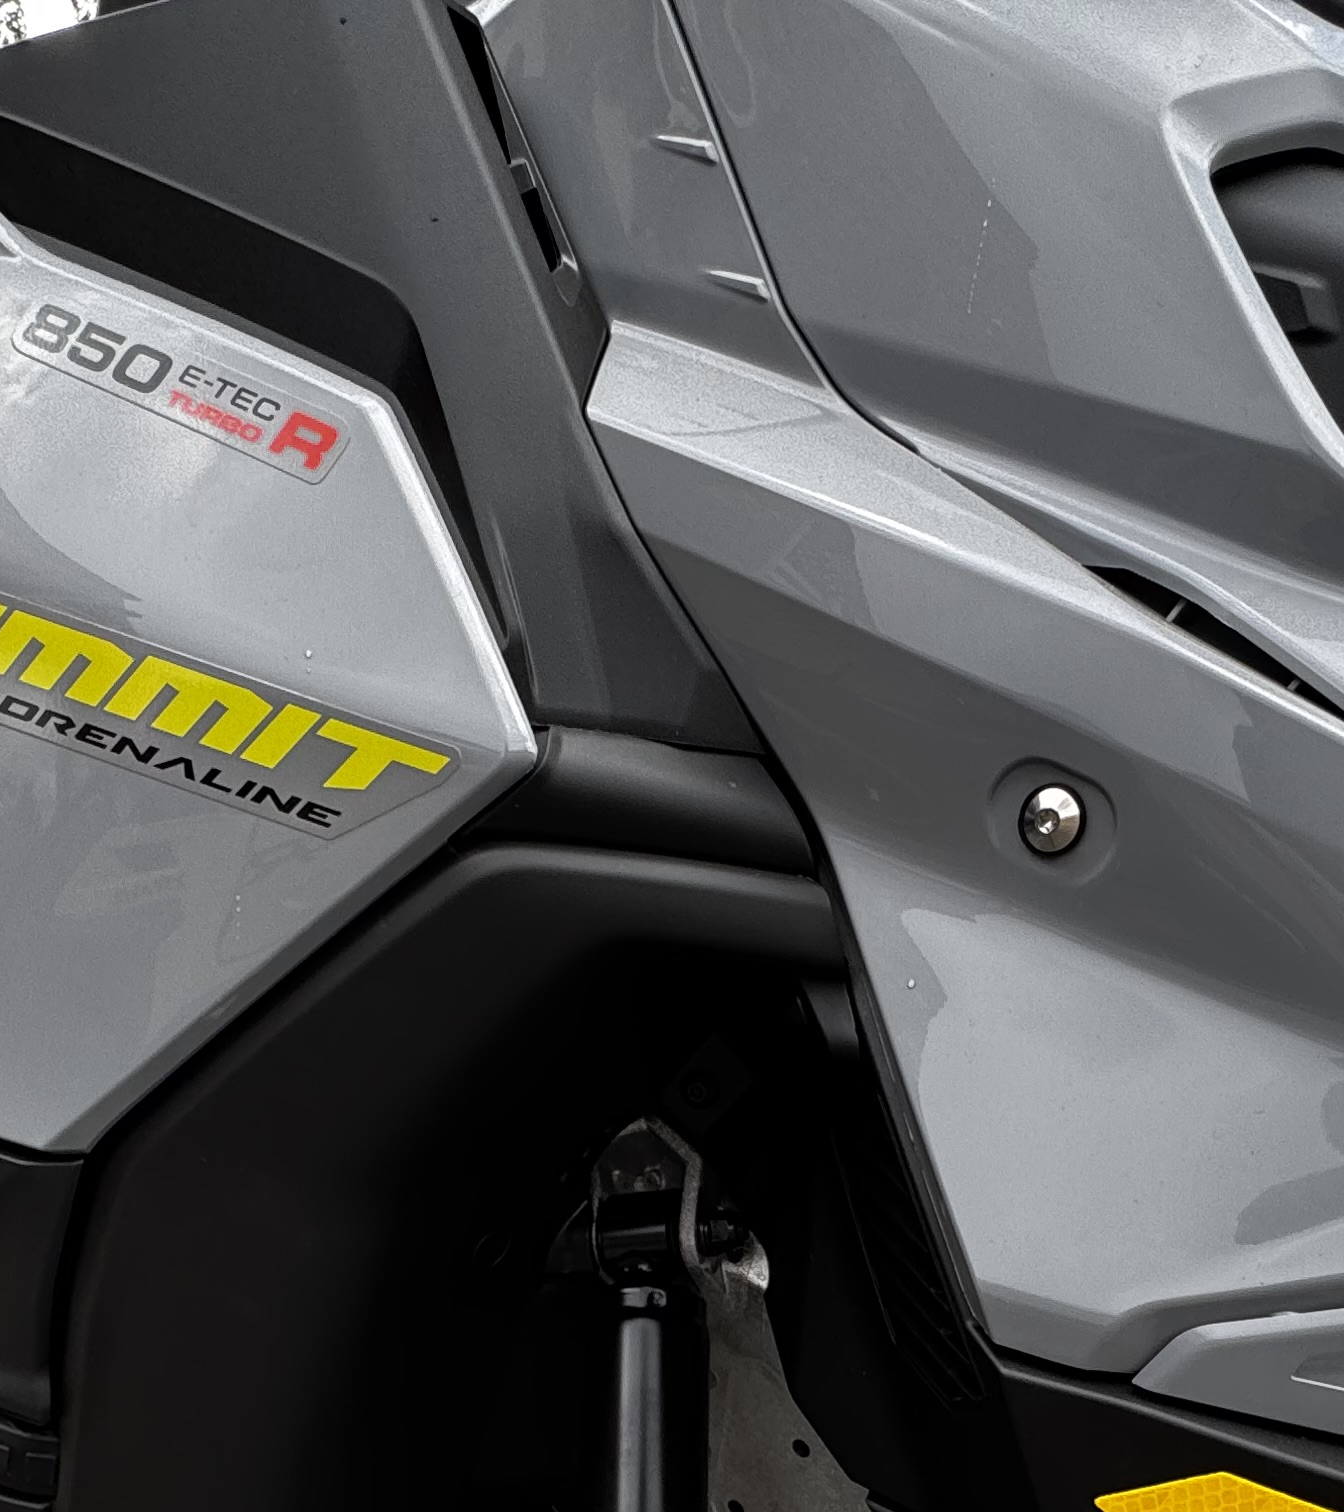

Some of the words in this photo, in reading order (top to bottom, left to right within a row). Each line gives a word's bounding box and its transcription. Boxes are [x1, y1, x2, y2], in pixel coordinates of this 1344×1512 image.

[22, 303, 174, 394] 850
[177, 364, 281, 422] E-TEC
[267, 410, 340, 471] R
[168, 388, 264, 444] TURBO
